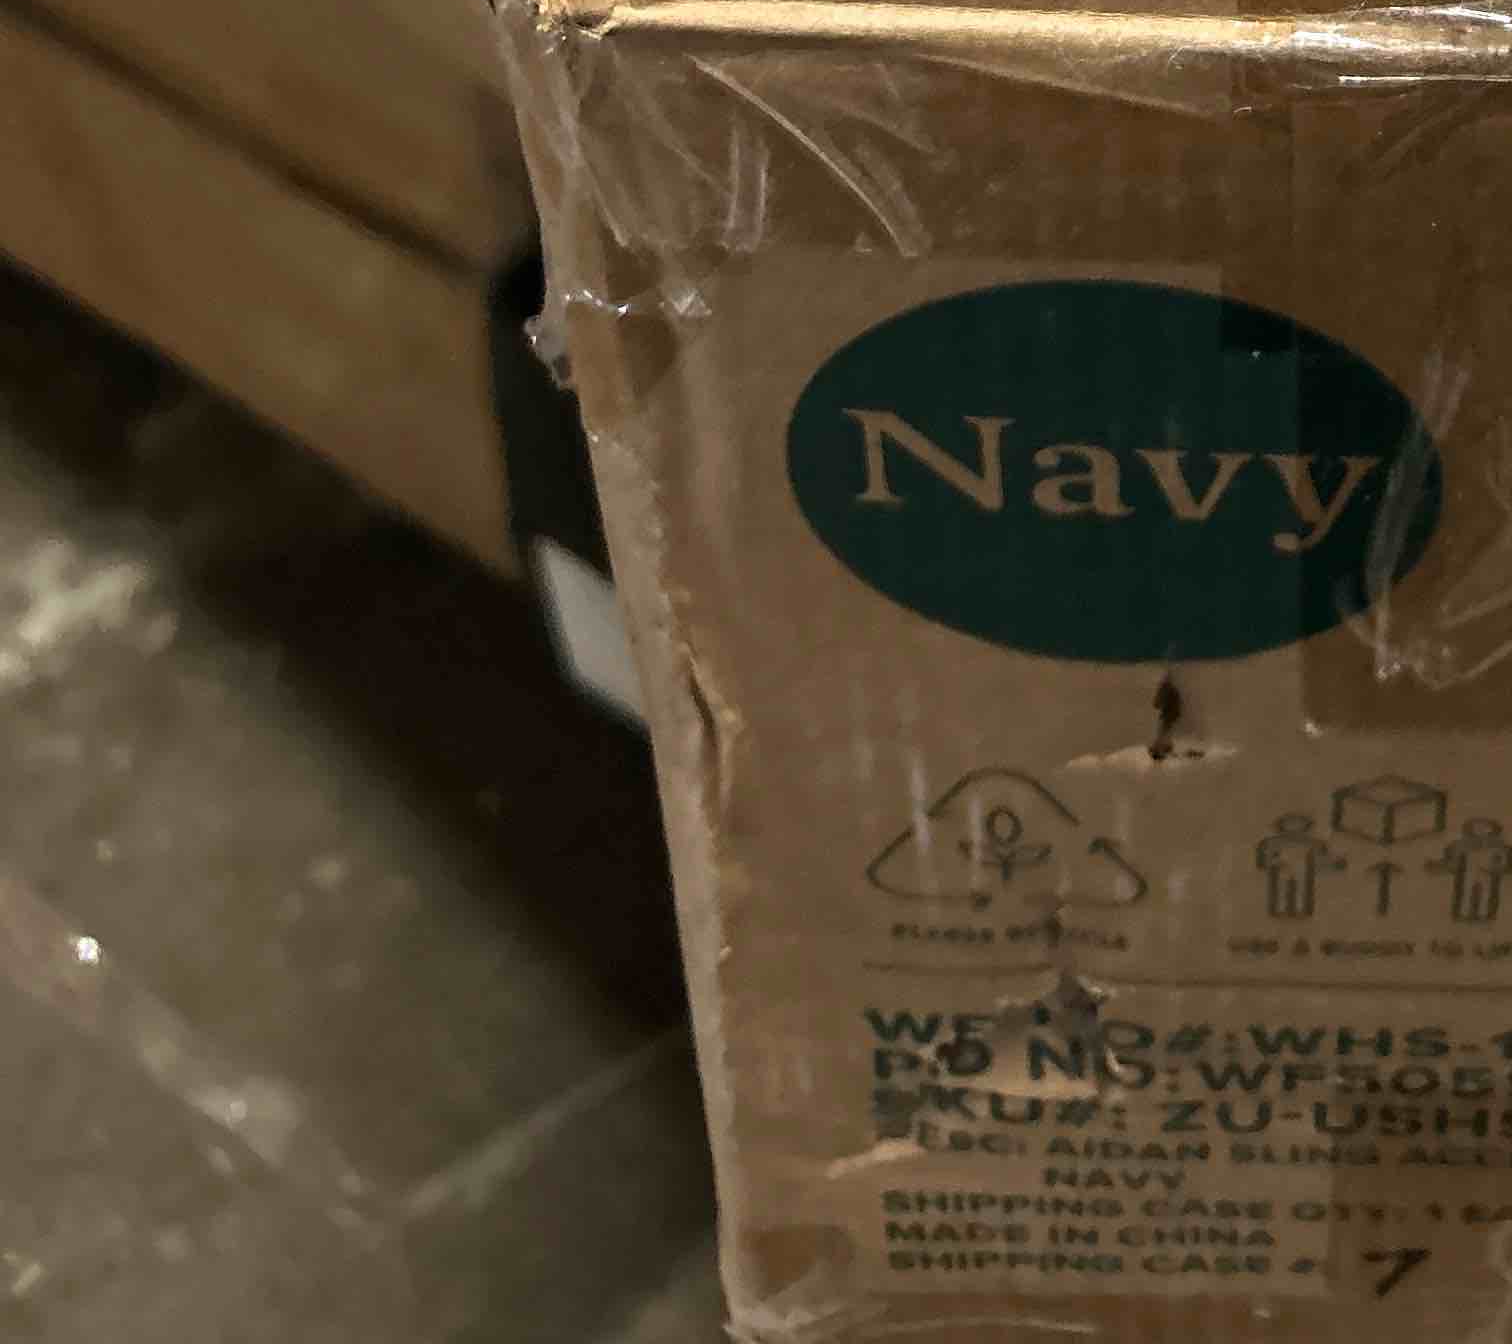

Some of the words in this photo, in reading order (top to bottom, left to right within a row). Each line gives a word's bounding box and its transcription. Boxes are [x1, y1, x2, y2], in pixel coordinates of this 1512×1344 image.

[842, 408, 1383, 553] Navy
[1043, 1167, 1189, 1190] NAVY
[881, 1189, 1123, 1216] SHIPPING
[884, 1221, 1030, 1244] MADE
[1047, 1224, 1099, 1246] IN
[1116, 1225, 1276, 1248] CHINA
[889, 1249, 1123, 1273] SHIPPING
